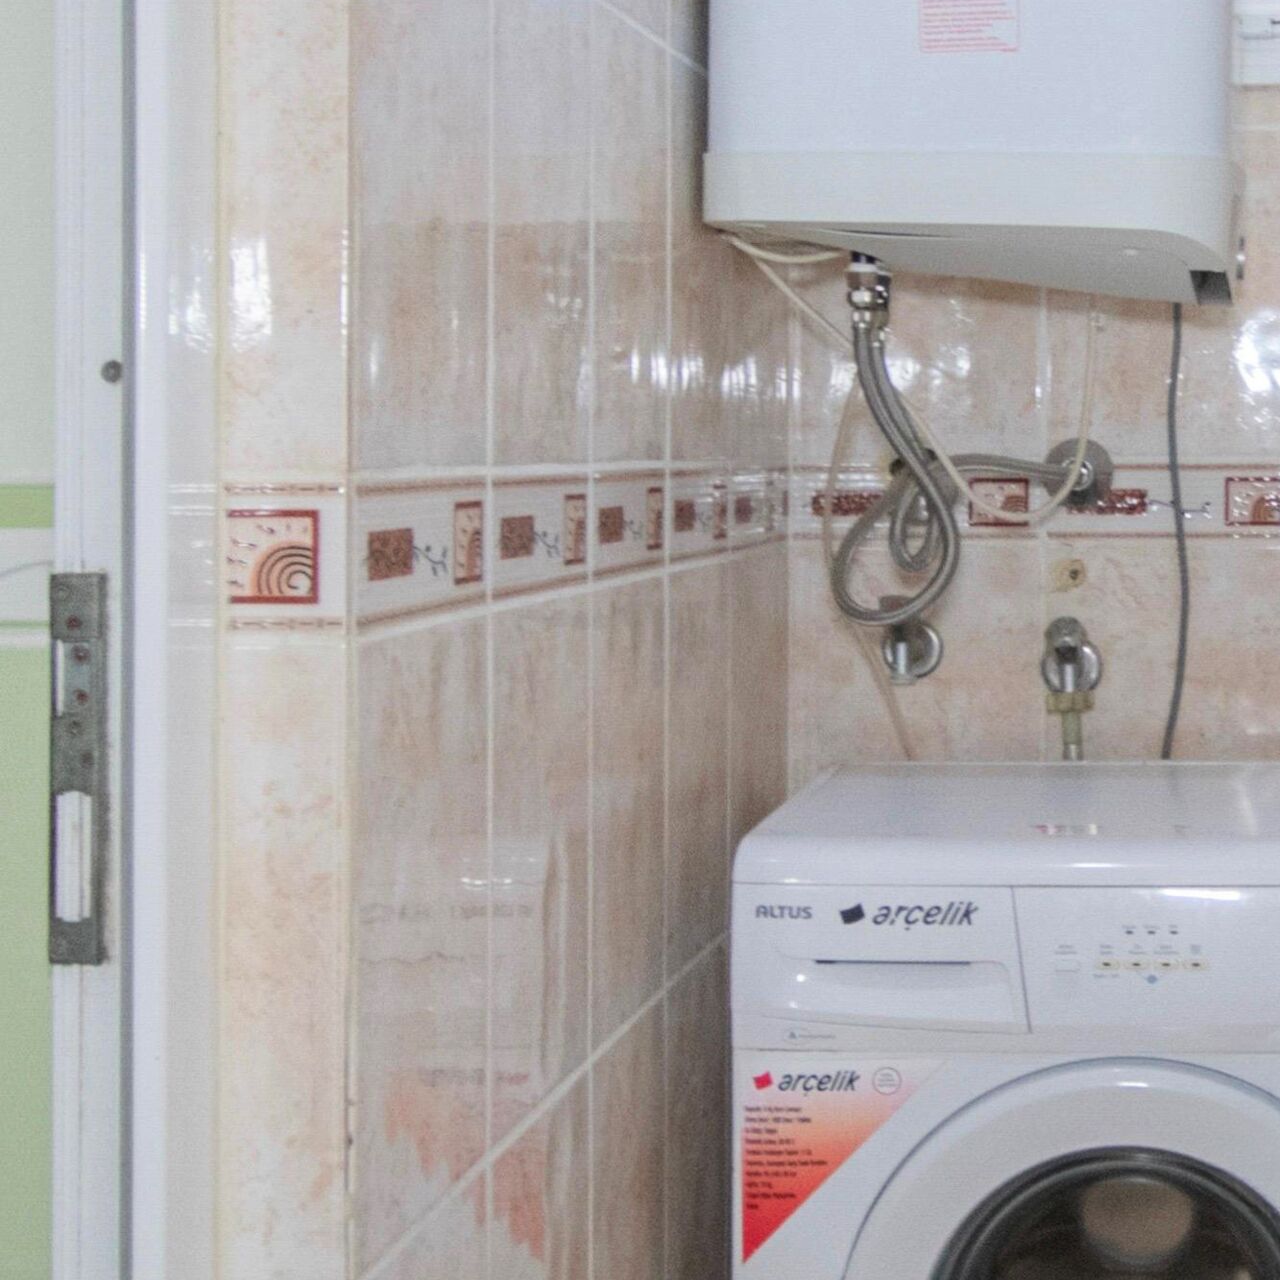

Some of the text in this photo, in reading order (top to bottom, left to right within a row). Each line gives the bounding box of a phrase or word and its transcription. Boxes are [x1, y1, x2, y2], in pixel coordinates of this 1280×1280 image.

[755, 904, 813, 920] ALTUS
[872, 901, 979, 931] arçelik
[777, 1070, 861, 1097] arçelik
